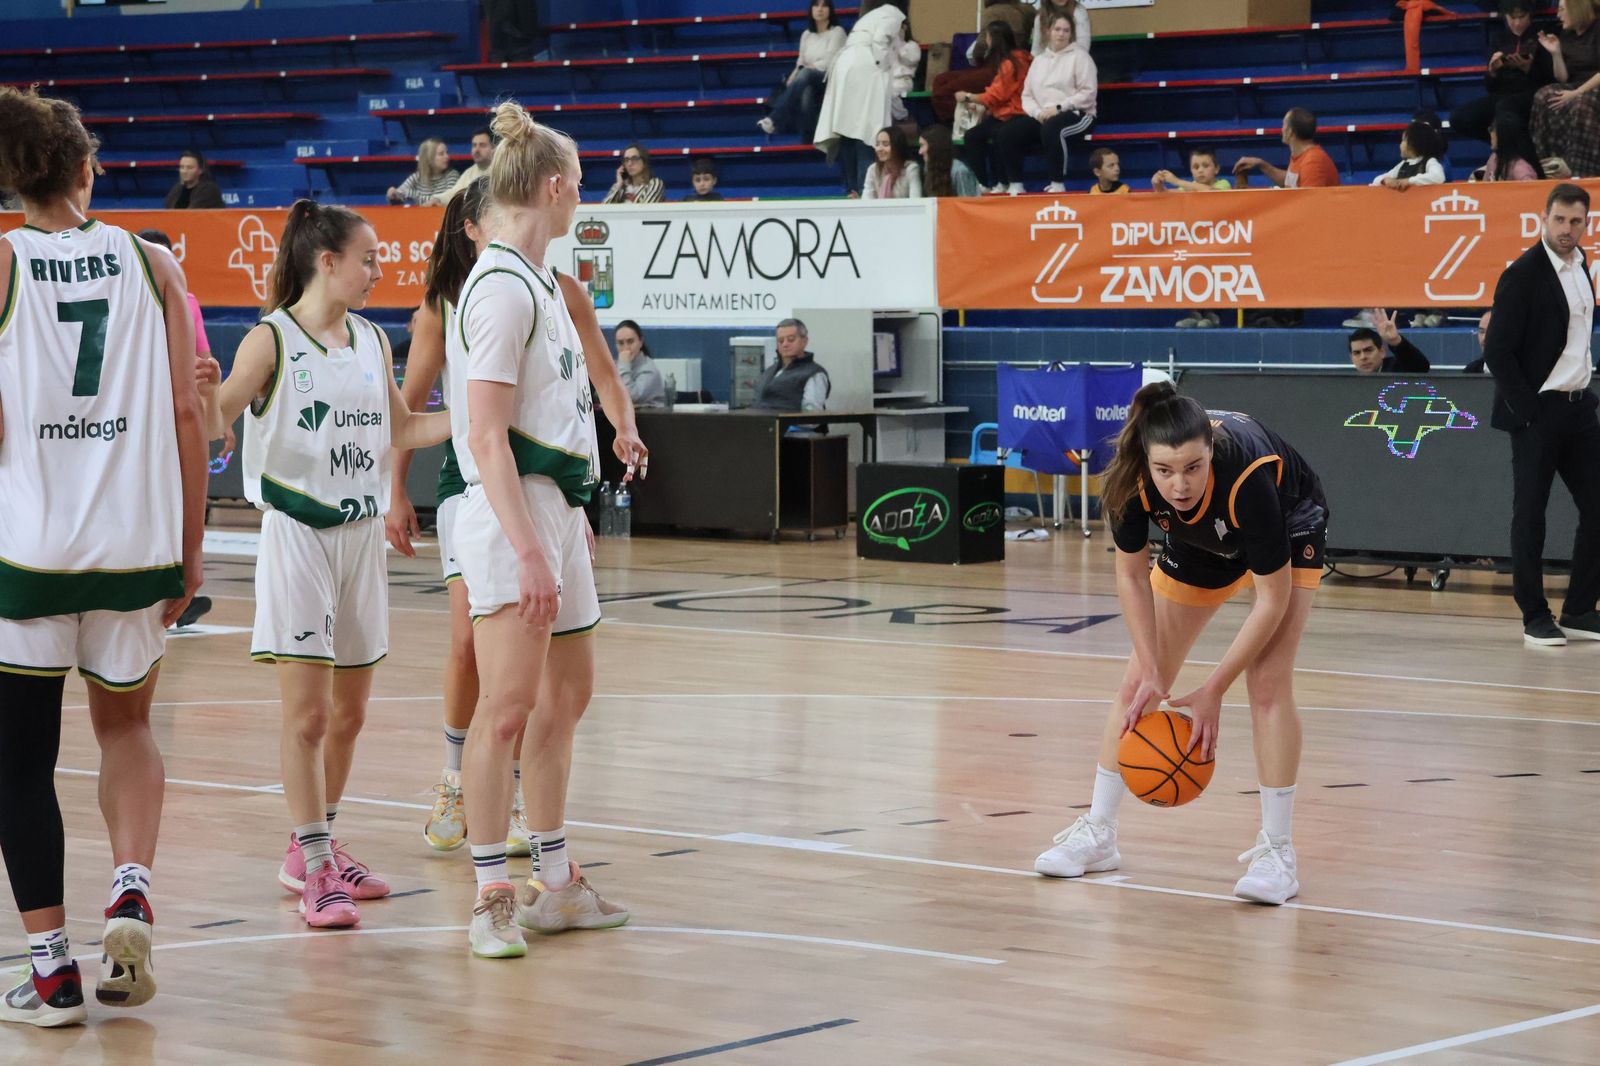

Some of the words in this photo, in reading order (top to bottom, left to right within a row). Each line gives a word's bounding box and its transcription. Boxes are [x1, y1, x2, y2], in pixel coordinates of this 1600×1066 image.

[30, 253, 121, 283] RIVERS
[642, 217, 861, 281] ZAMORA
[642, 293, 776, 311] AYUNTAMIENTO
[1100, 264, 1265, 303] ZAMORA
[56, 298, 110, 397] 7
[1013, 404, 1066, 423] molten
[330, 441, 375, 479] Mijas
